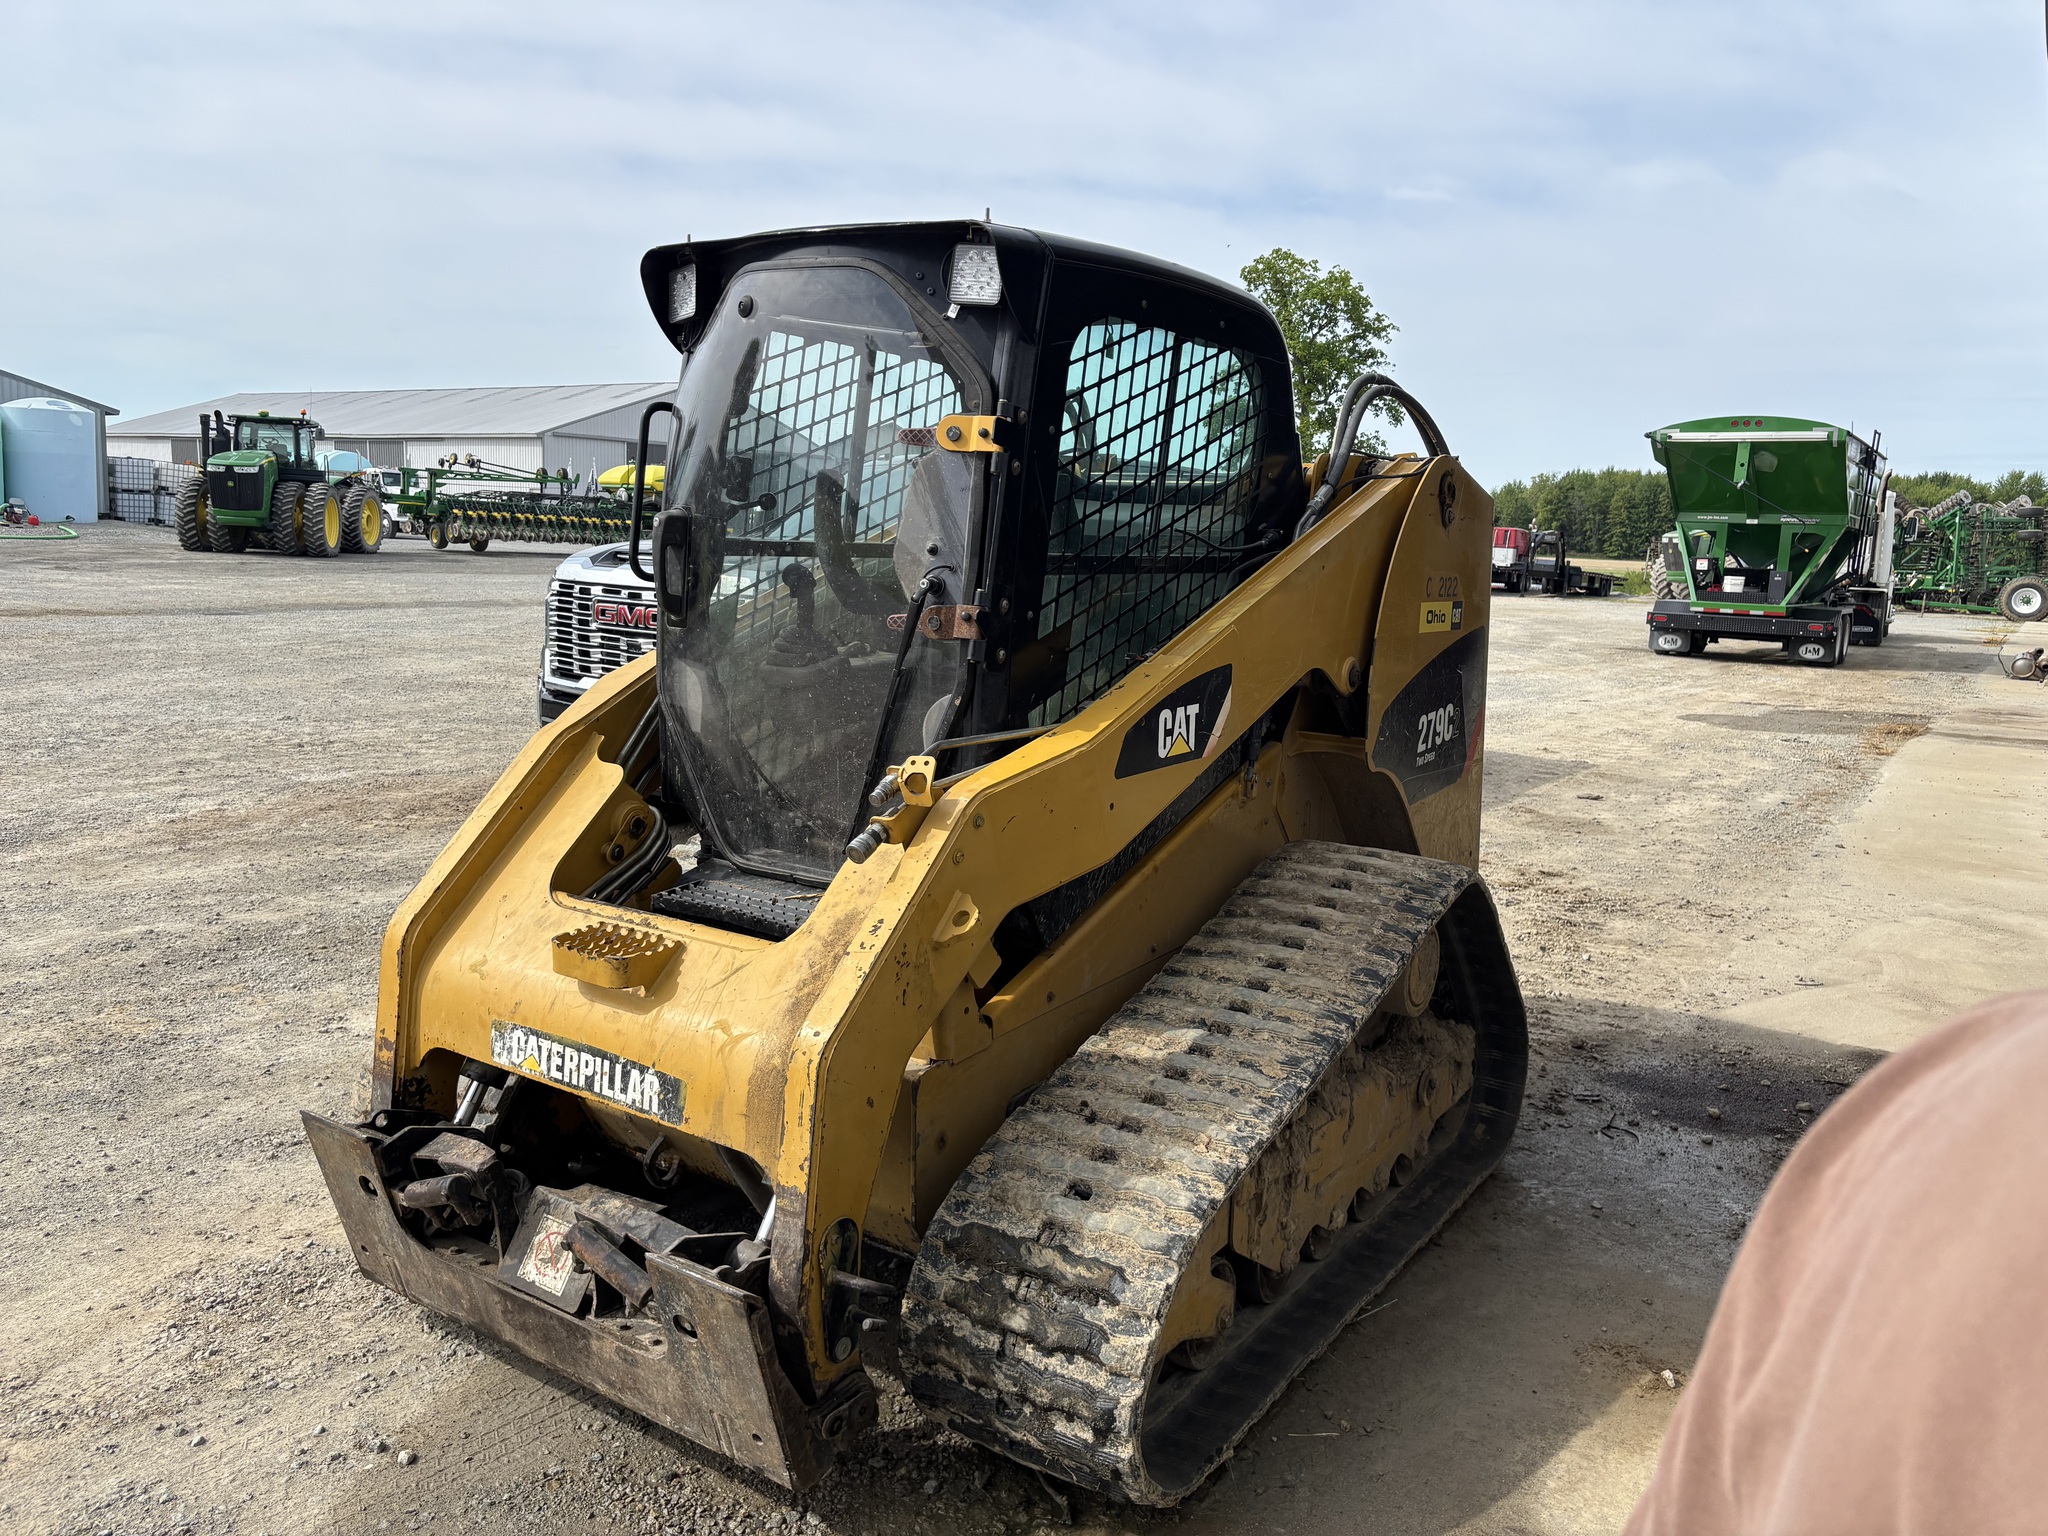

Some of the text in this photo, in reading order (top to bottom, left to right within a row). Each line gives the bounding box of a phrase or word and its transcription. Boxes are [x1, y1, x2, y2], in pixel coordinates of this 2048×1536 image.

[1438, 576, 1459, 598] 2122
[595, 602, 658, 628] GMC
[1426, 608, 1462, 625] Ohio CAT
[1801, 646, 1820, 657] J&M
[1158, 703, 1200, 759] CAT
[511, 1029, 661, 1114] CATERPILLAR
